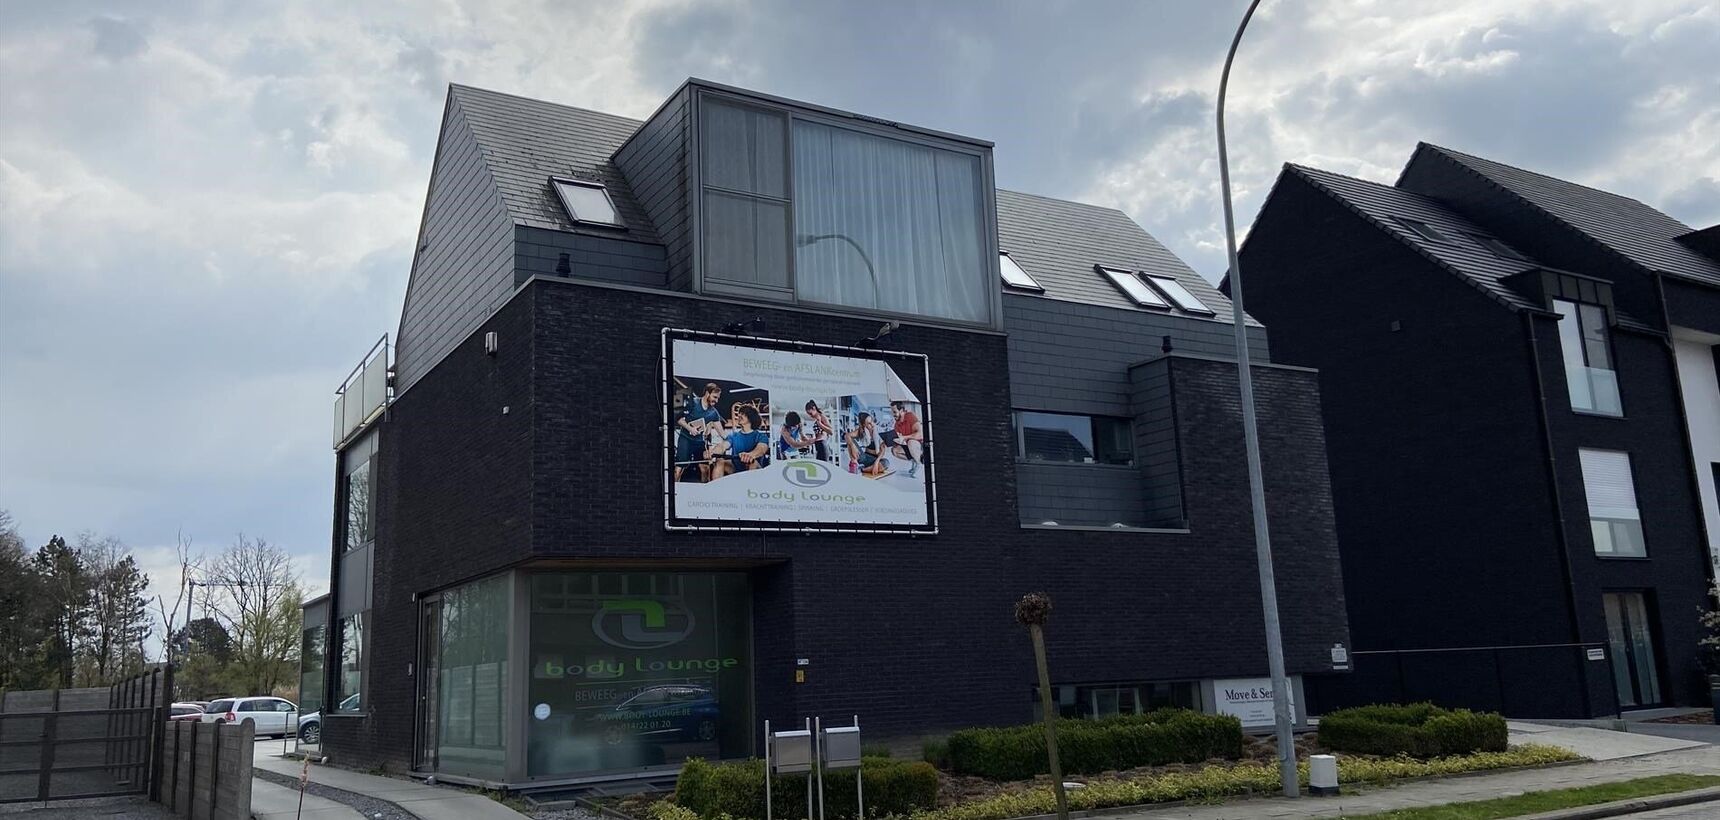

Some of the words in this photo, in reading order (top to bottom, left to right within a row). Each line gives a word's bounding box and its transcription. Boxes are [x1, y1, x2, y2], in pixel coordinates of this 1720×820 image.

[747, 488, 795, 503] body
[801, 490, 866, 505] lounge
[545, 659, 625, 678] body
[635, 655, 739, 673] lounge
[1225, 688, 1250, 701] Move
[1251, 688, 1258, 700] &
